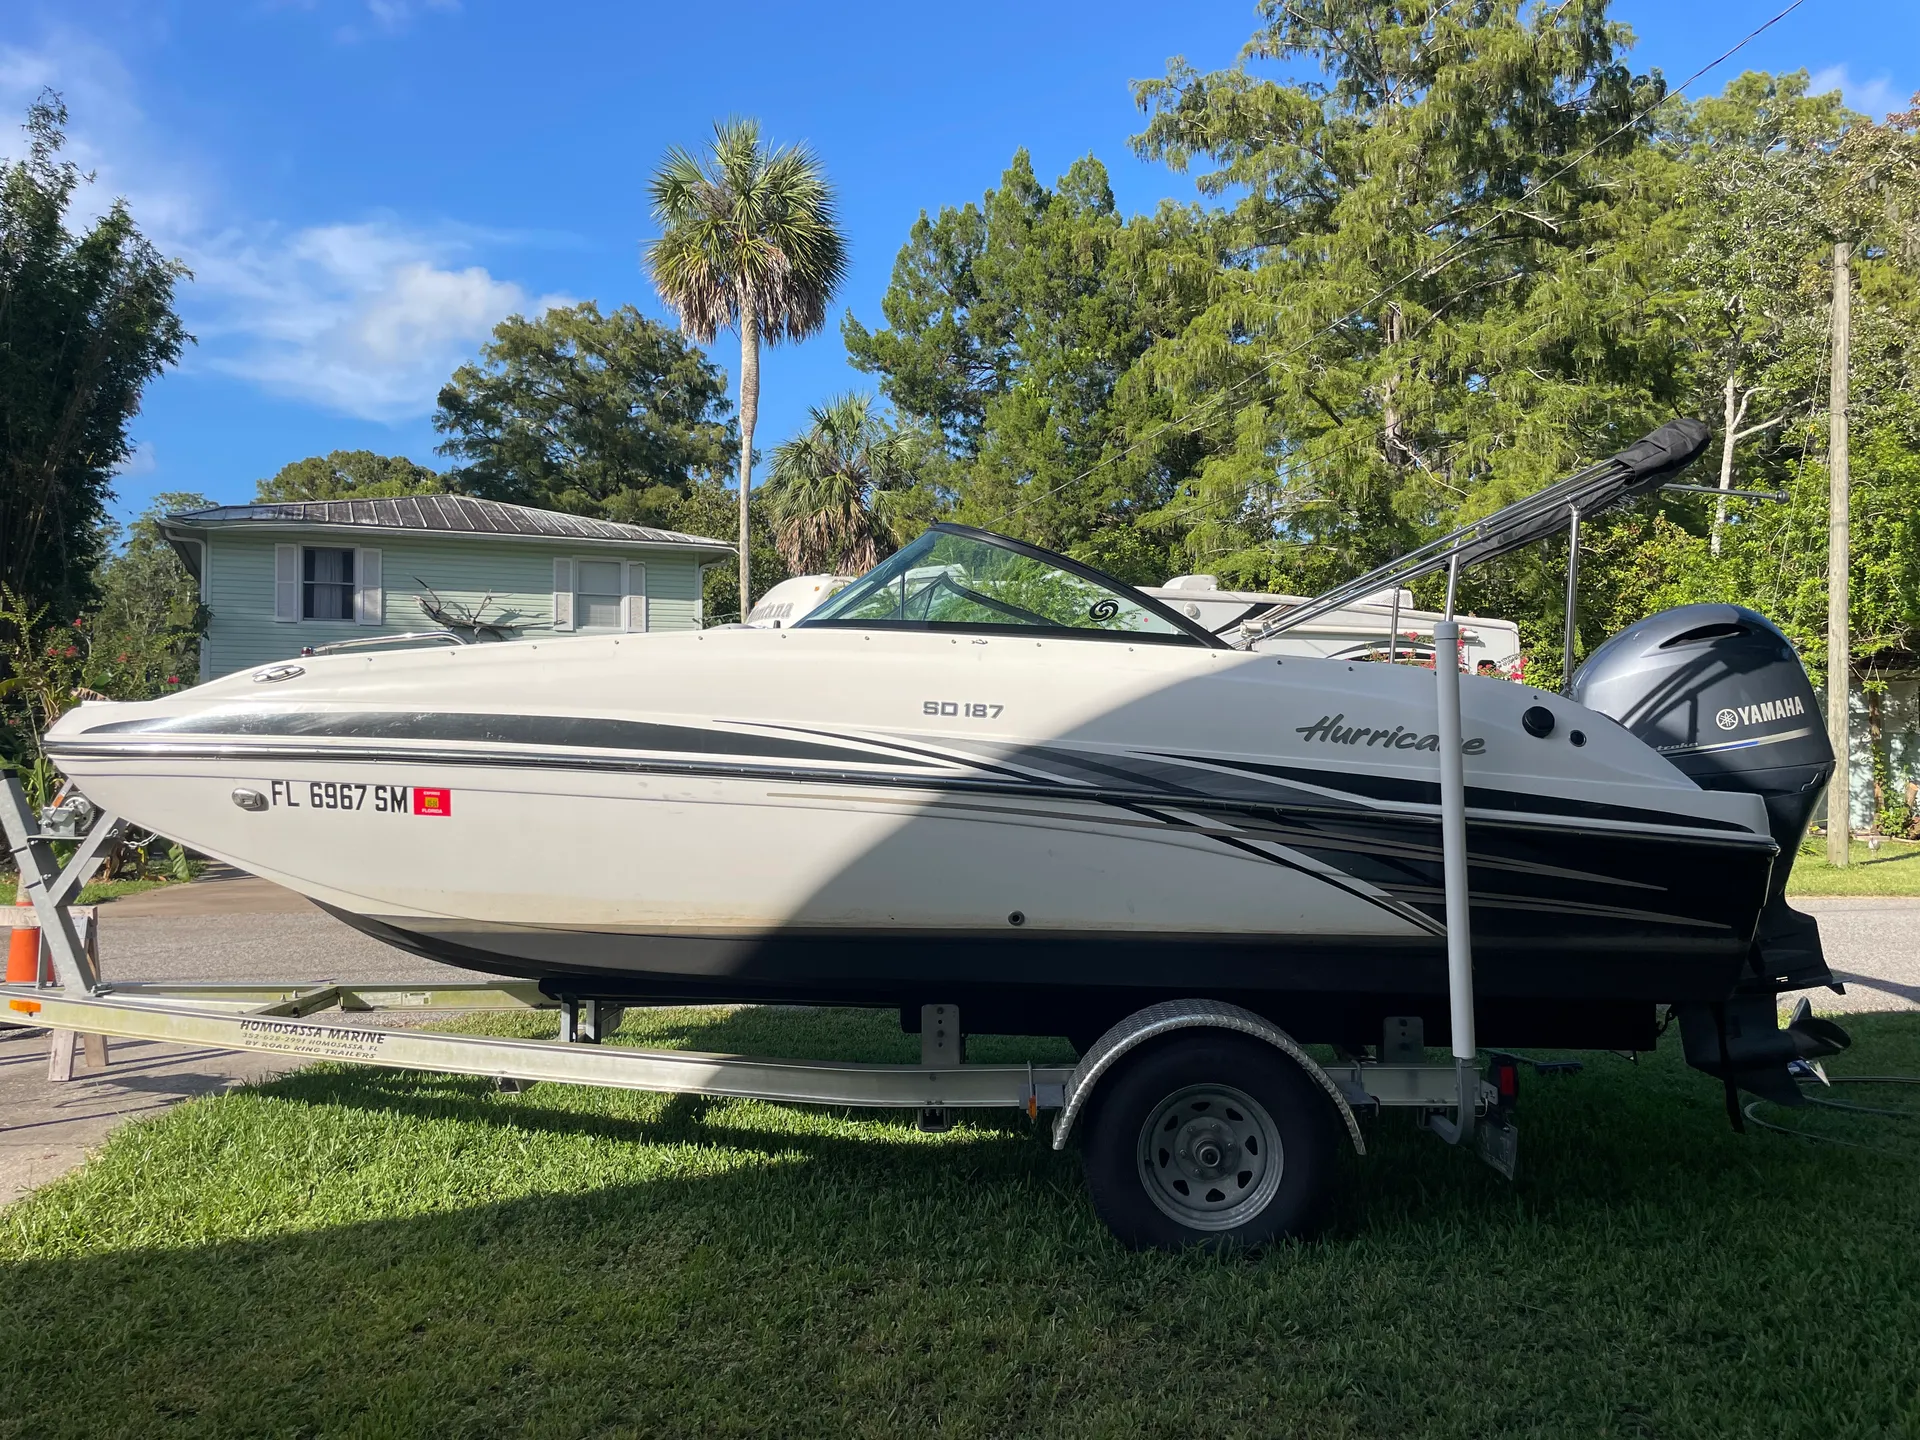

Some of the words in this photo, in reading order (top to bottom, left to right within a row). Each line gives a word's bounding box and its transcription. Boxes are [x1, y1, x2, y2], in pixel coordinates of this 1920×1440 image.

[923, 701, 959, 716] SD
[964, 702, 1005, 719] 187
[1737, 696, 1805, 725] YAMAHA
[1295, 713, 1487, 755] Hurricae
[271, 780, 300, 807] FL
[309, 782, 367, 810] 6967
[375, 785, 408, 813] SM
[240, 1020, 322, 1038] HOMOSASSA
[327, 1028, 386, 1044] MARINE
[261, 1042, 290, 1050] ROAD
[294, 1045, 320, 1053] KING
[324, 1048, 376, 1059] TRAILERS
